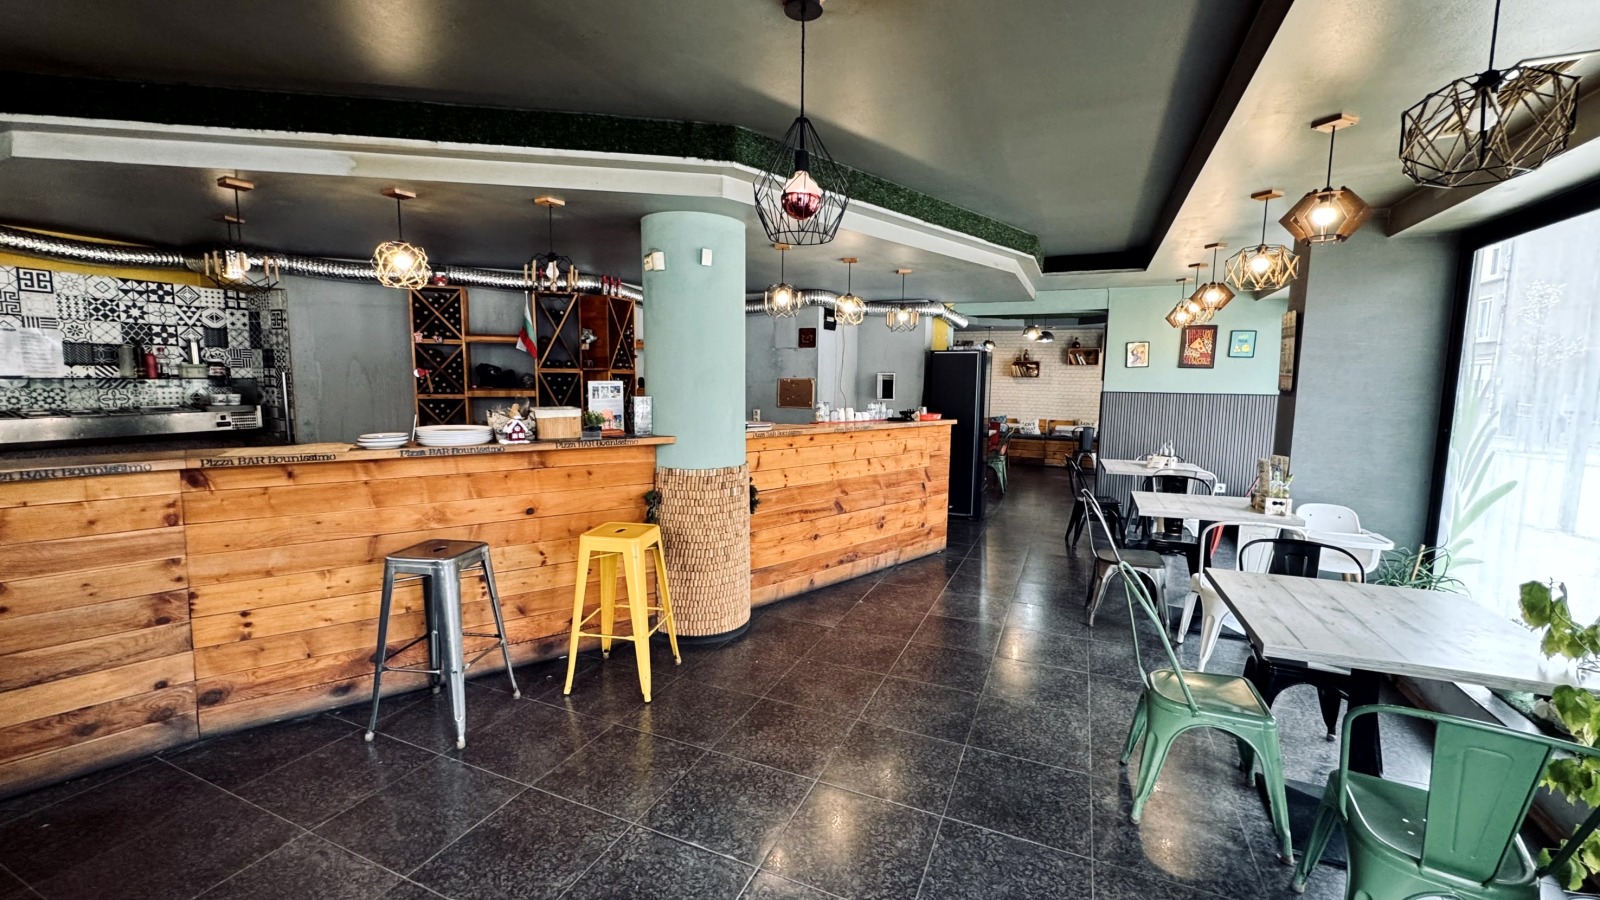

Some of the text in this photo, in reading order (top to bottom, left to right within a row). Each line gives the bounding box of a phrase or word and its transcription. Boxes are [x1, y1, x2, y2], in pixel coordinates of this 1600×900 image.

[578, 440, 595, 448] BAR
[400, 445, 506, 457] Pizza BAR Bounissimo
[200, 453, 337, 467] Pizza BAR Bounissimo
[20, 468, 58, 480] BAR
[62, 463, 152, 477] Bounissimo
